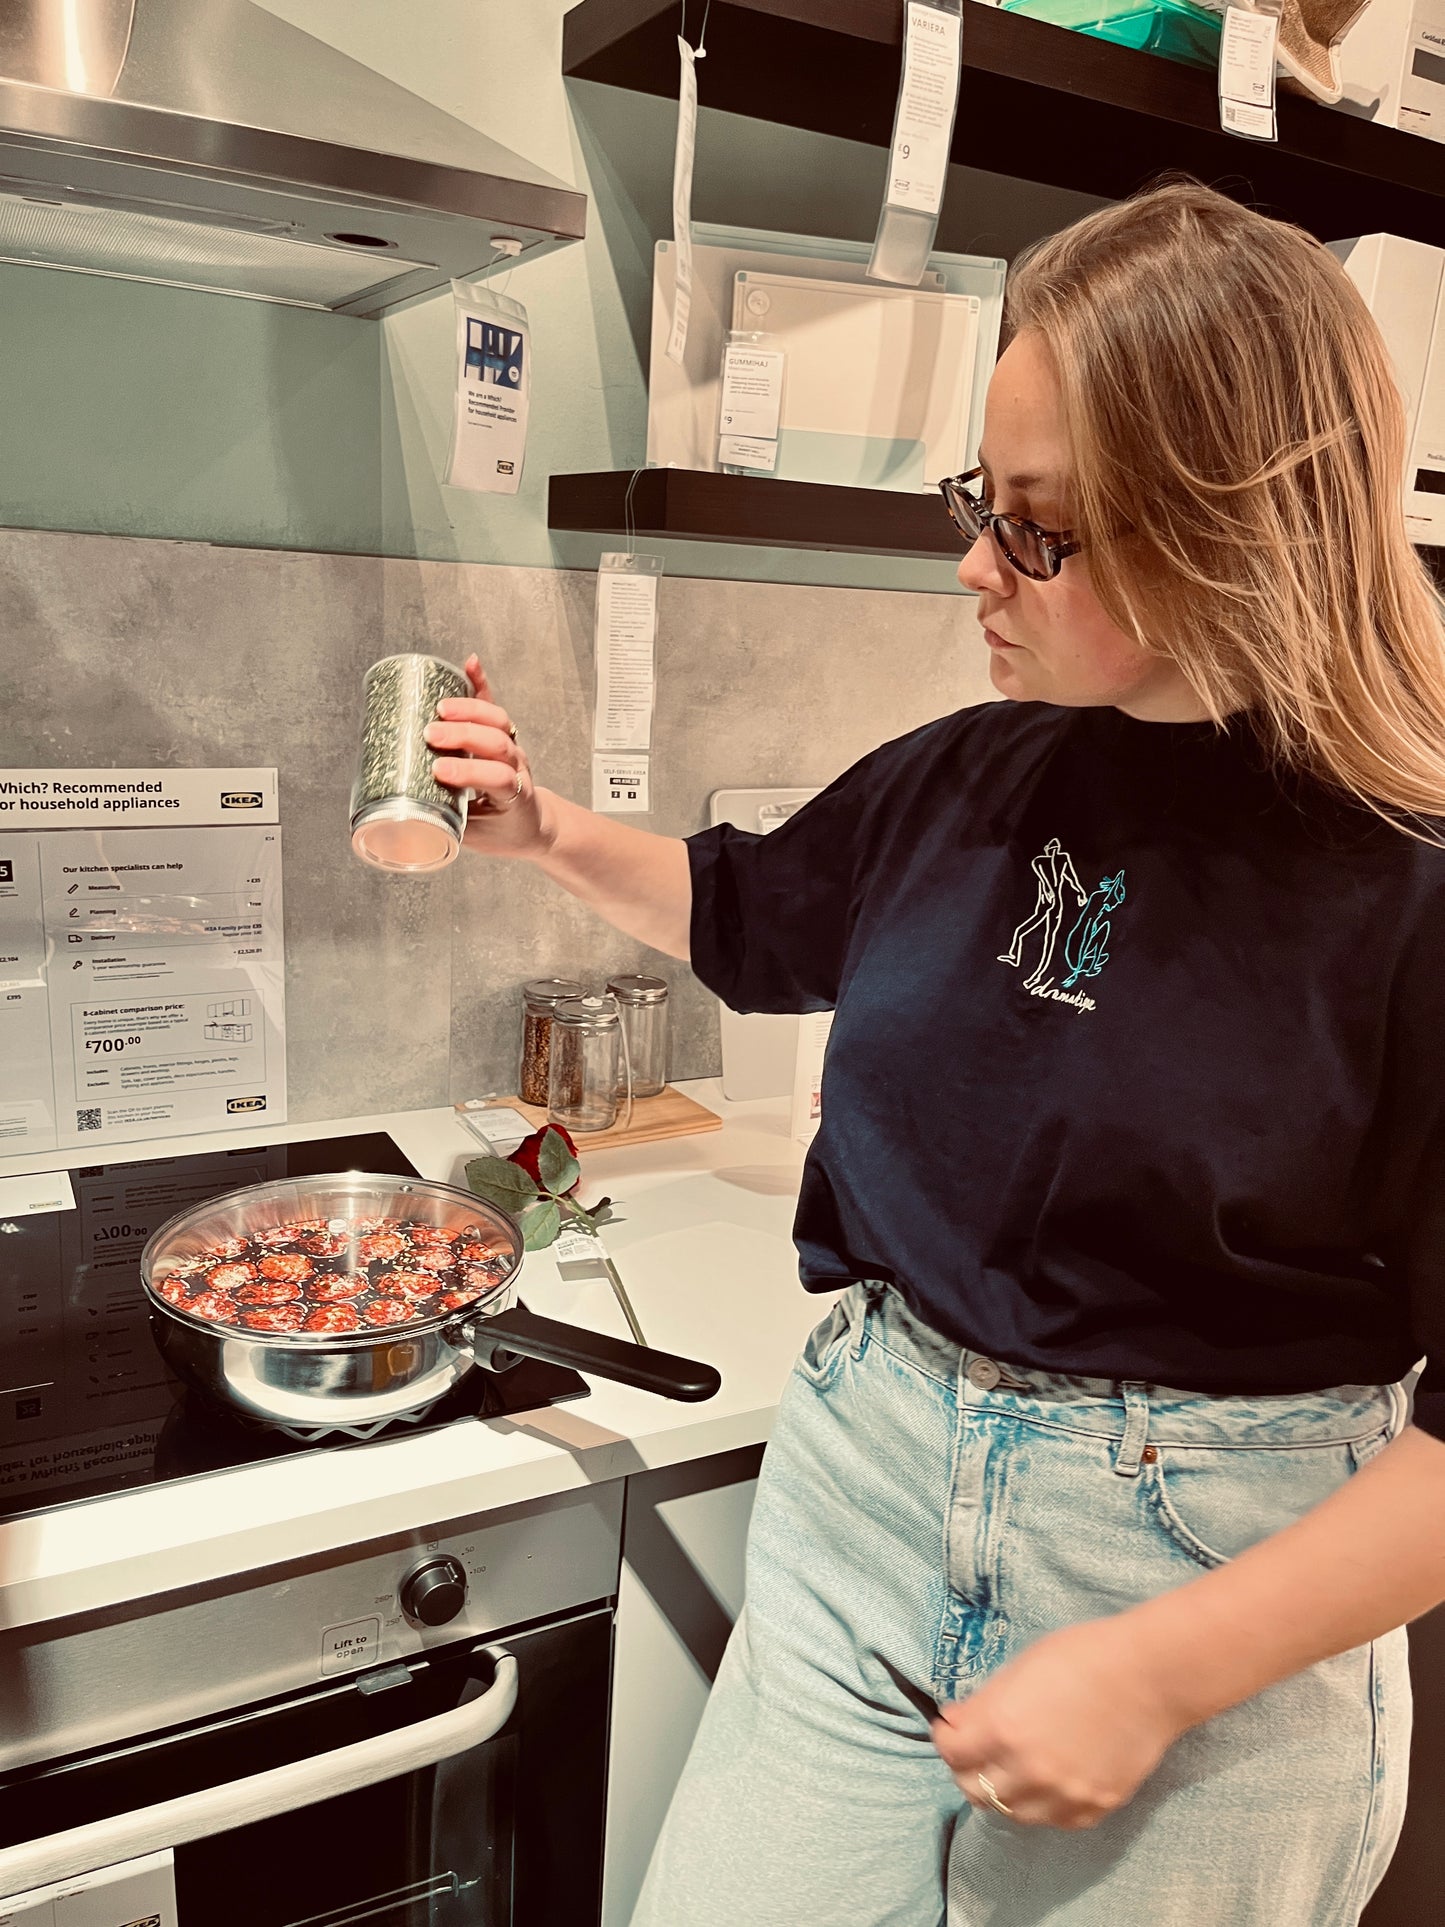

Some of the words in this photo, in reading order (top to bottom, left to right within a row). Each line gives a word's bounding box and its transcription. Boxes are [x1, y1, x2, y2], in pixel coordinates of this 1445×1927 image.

[912, 17, 945, 35] VARIERA
[53, 782, 162, 794] Recommended
[20, 798, 99, 810] household
[103, 798, 180, 811] appliances
[224, 795, 260, 806] IKEA
[111, 864, 150, 872] specialists
[83, 1008, 118, 1016] 8-cabinet
[120, 1006, 164, 1014] comparison
[86, 1036, 141, 1054] £700.00
[230, 1099, 264, 1110] IKEA
[334, 1639, 353, 1650] Lift
[356, 1636, 367, 1644] to
[336, 1646, 364, 1659] open
